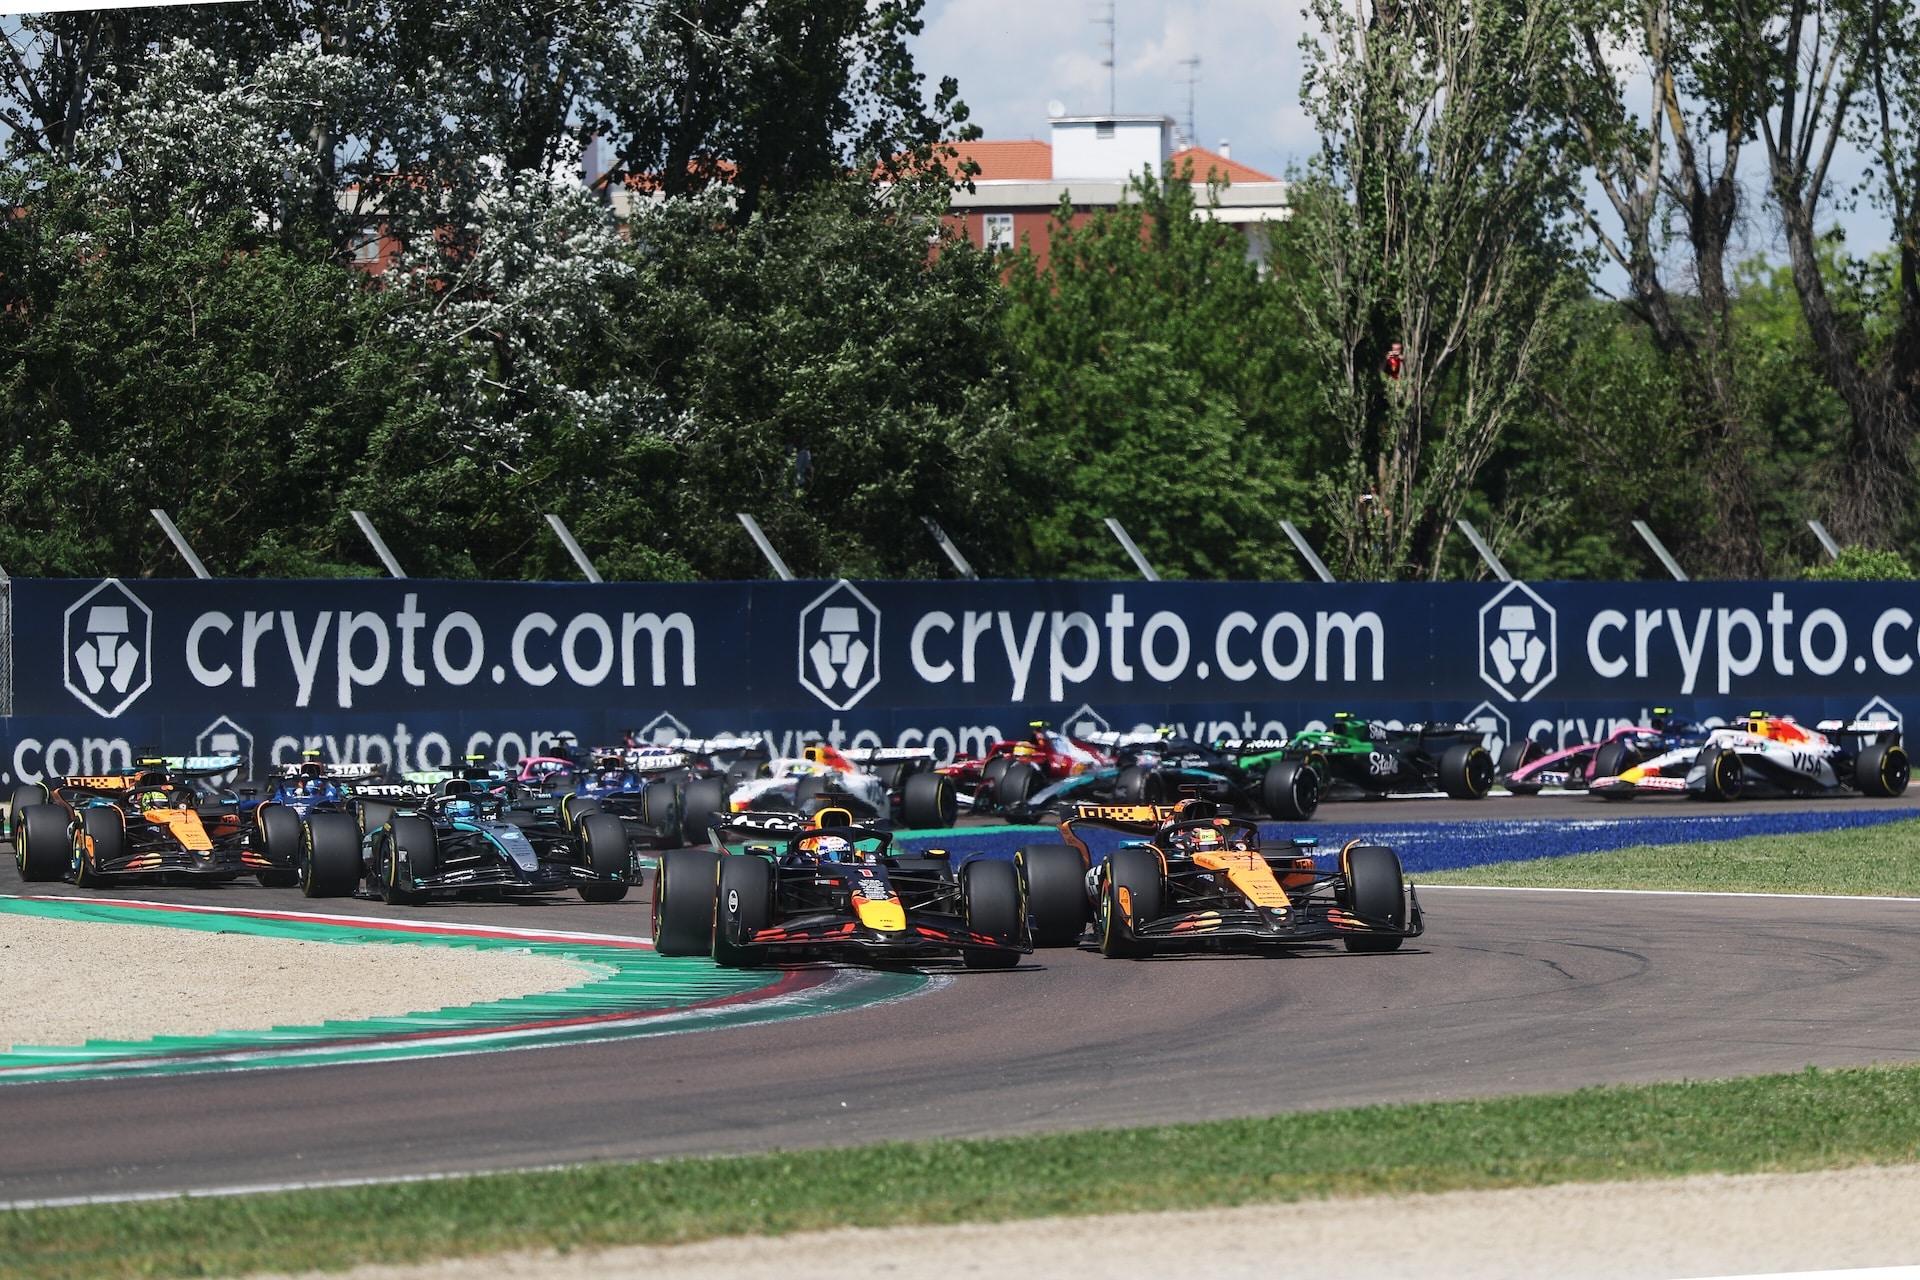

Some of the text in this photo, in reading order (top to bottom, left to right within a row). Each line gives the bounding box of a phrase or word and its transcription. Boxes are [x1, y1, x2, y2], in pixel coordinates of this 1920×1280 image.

[186, 593, 696, 708] crypto.com
[911, 594, 1384, 702] crypto.com
[1587, 592, 1920, 694] crypto.c
[1369, 751, 1399, 775] Stake
[1791, 751, 1822, 777] VISA
